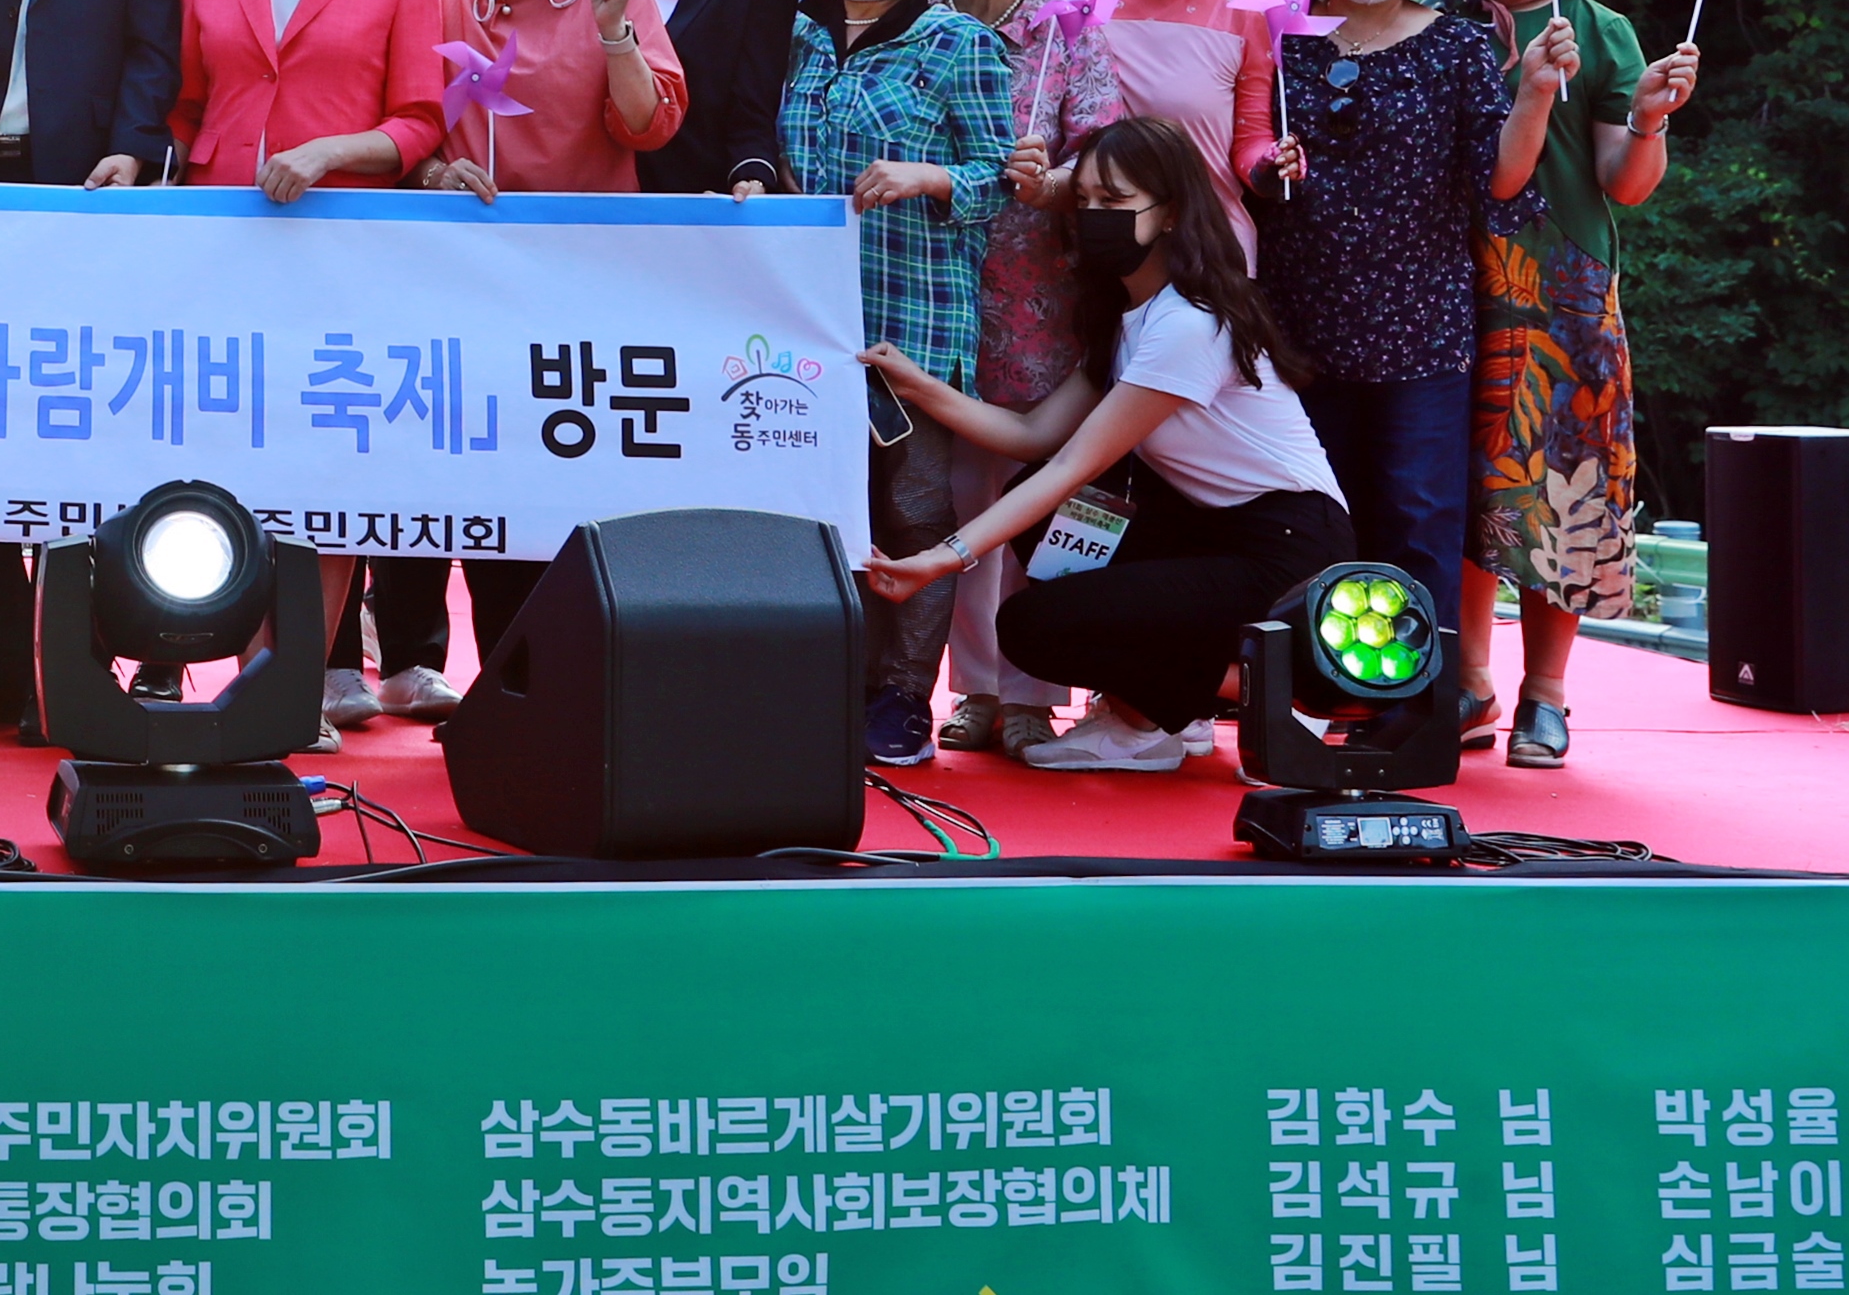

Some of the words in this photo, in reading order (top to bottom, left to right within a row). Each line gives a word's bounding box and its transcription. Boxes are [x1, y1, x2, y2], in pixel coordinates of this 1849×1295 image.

[530, 341, 690, 458] 방문
[740, 391, 809, 421] 찾아가는
[1048, 529, 1110, 561] STAFF
[481, 1087, 1111, 1158] 삼수동바르게살기위원회
[1268, 1088, 1455, 1145] 김화수
[1499, 1089, 1551, 1145] 님
[1656, 1088, 1837, 1146] 박성율
[482, 1166, 1169, 1237] 삼수동지역사회보장협의체
[1270, 1161, 1458, 1218] 김석규
[1503, 1161, 1554, 1218] 님
[1659, 1160, 1841, 1218] 손남이
[1271, 1234, 1461, 1291] 김진필
[1506, 1234, 1557, 1290] 님
[1662, 1232, 1844, 1290] 심금술
